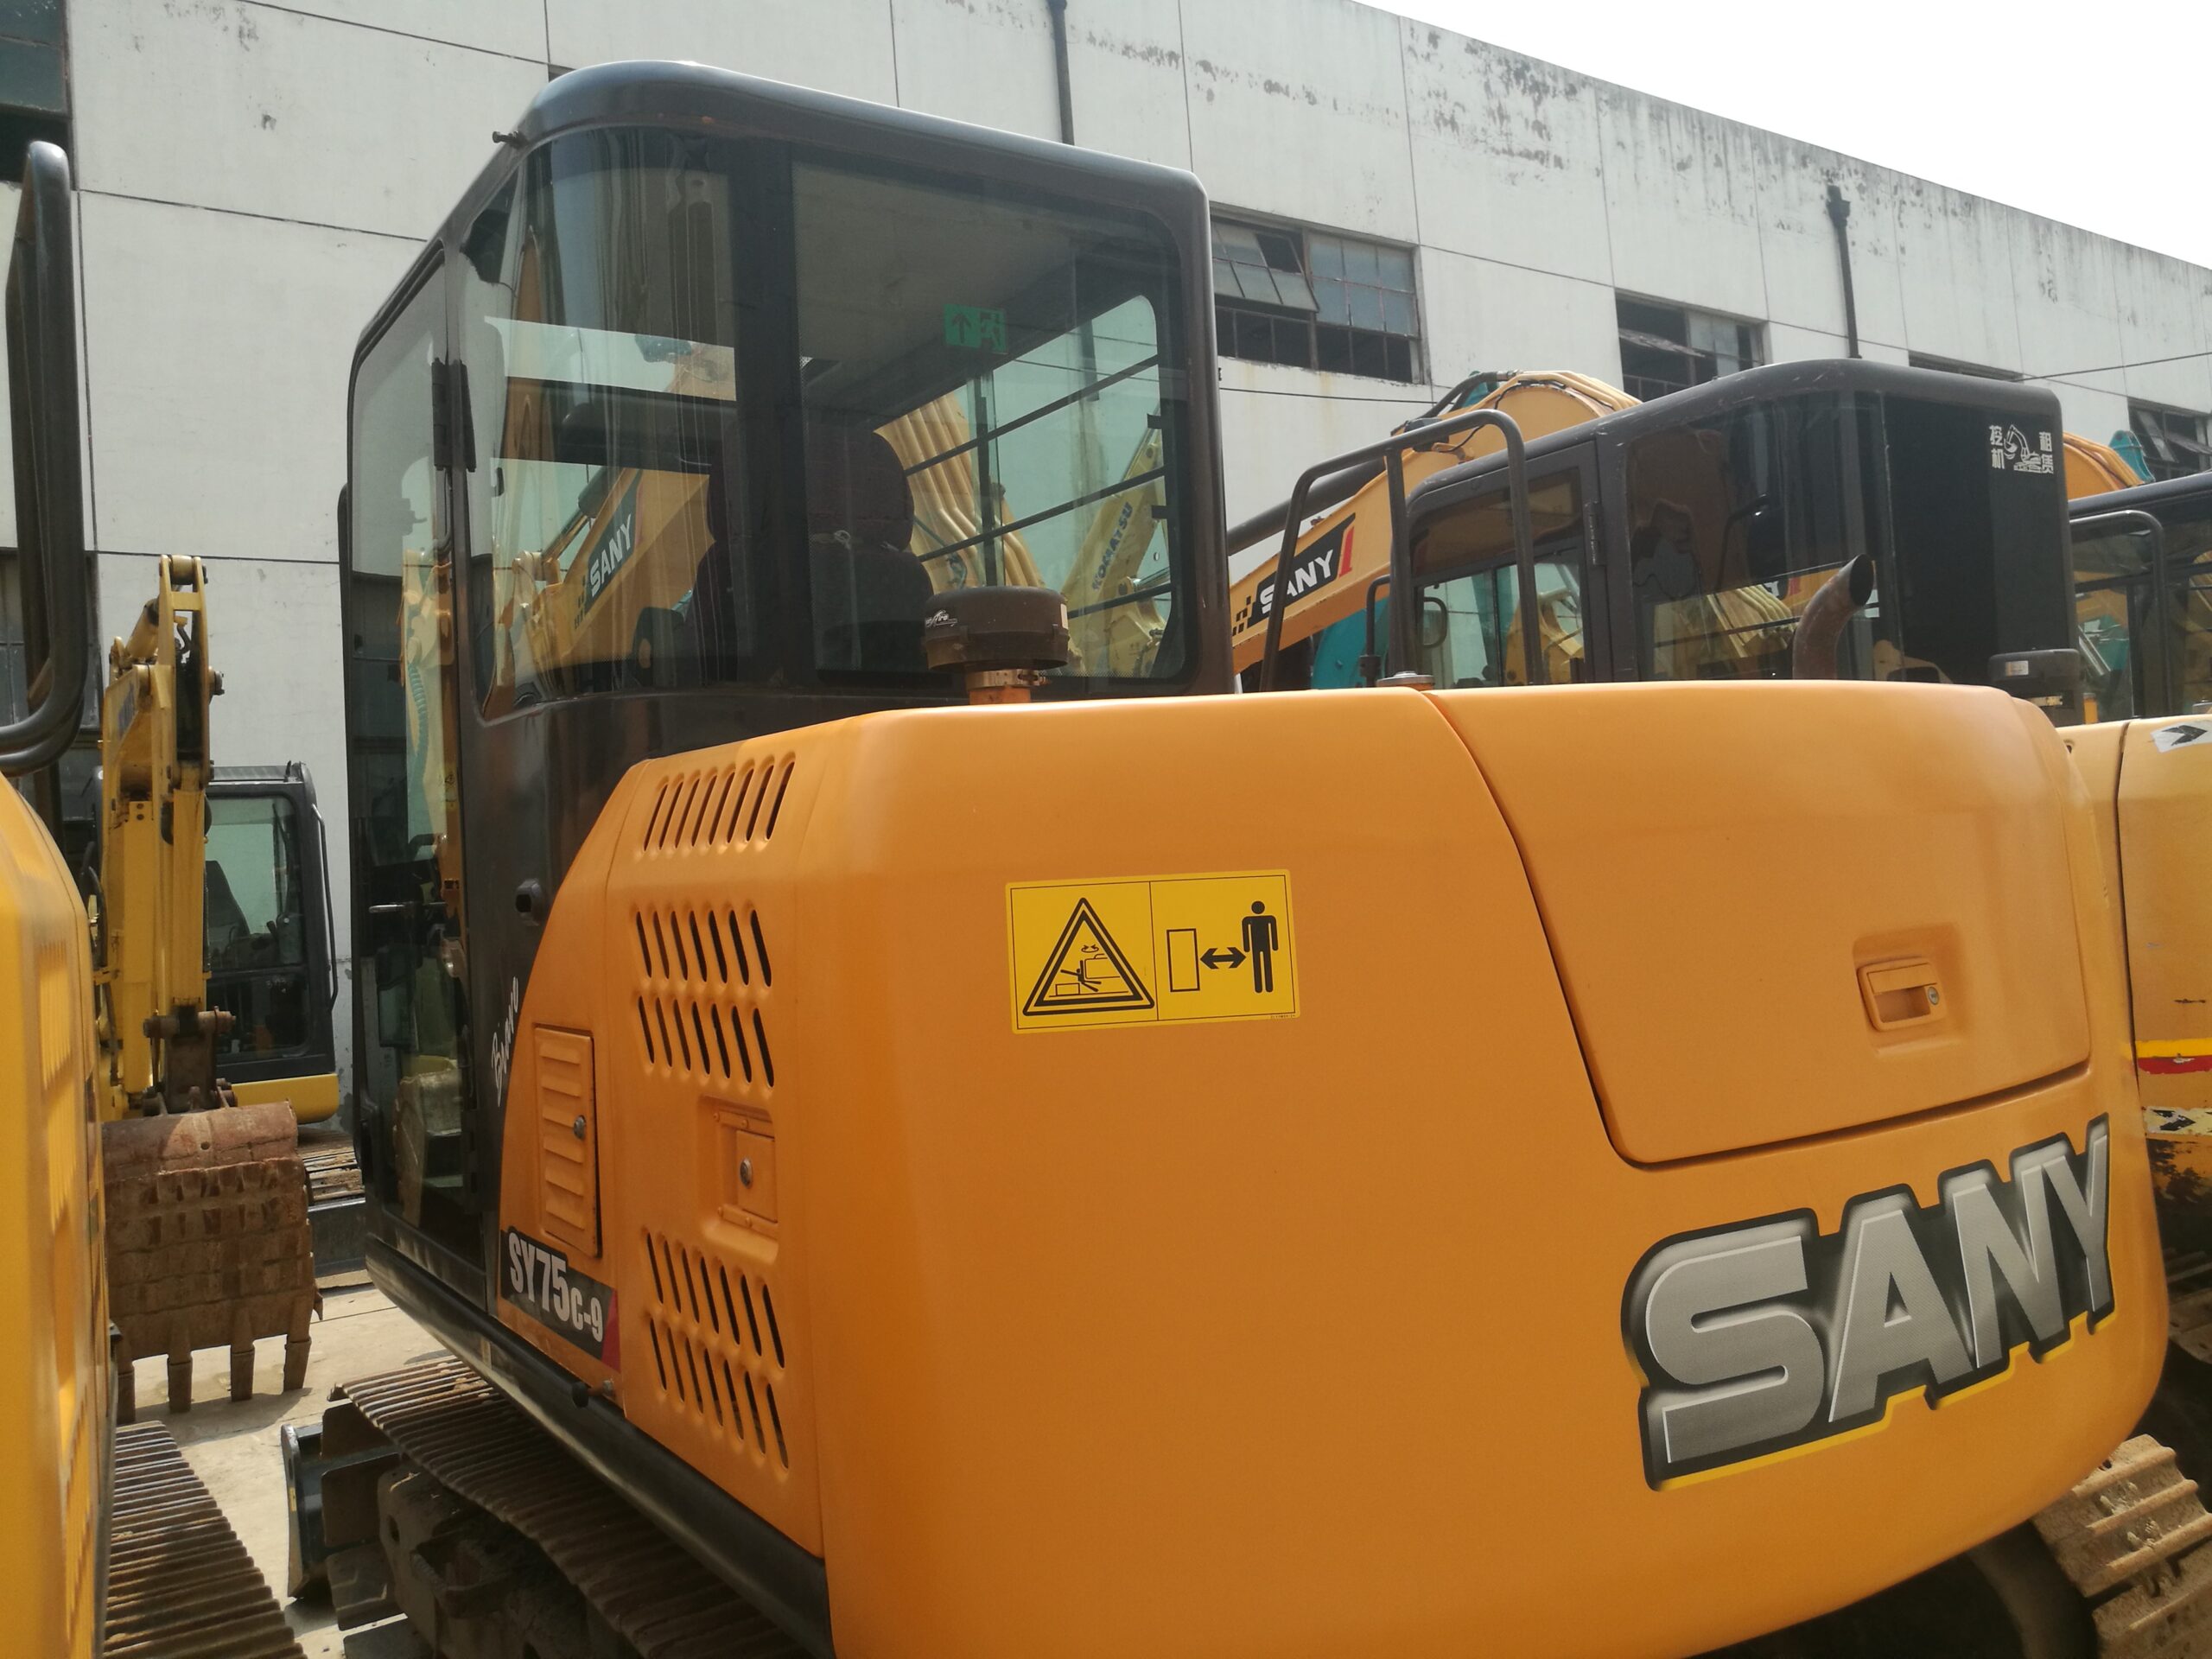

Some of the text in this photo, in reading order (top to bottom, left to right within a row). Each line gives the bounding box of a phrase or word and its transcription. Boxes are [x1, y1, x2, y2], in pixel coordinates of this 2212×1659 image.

[589, 513, 632, 598] SANY
[1091, 501, 1133, 591] KOMATSU
[1633, 1125, 2112, 1469] SANY
